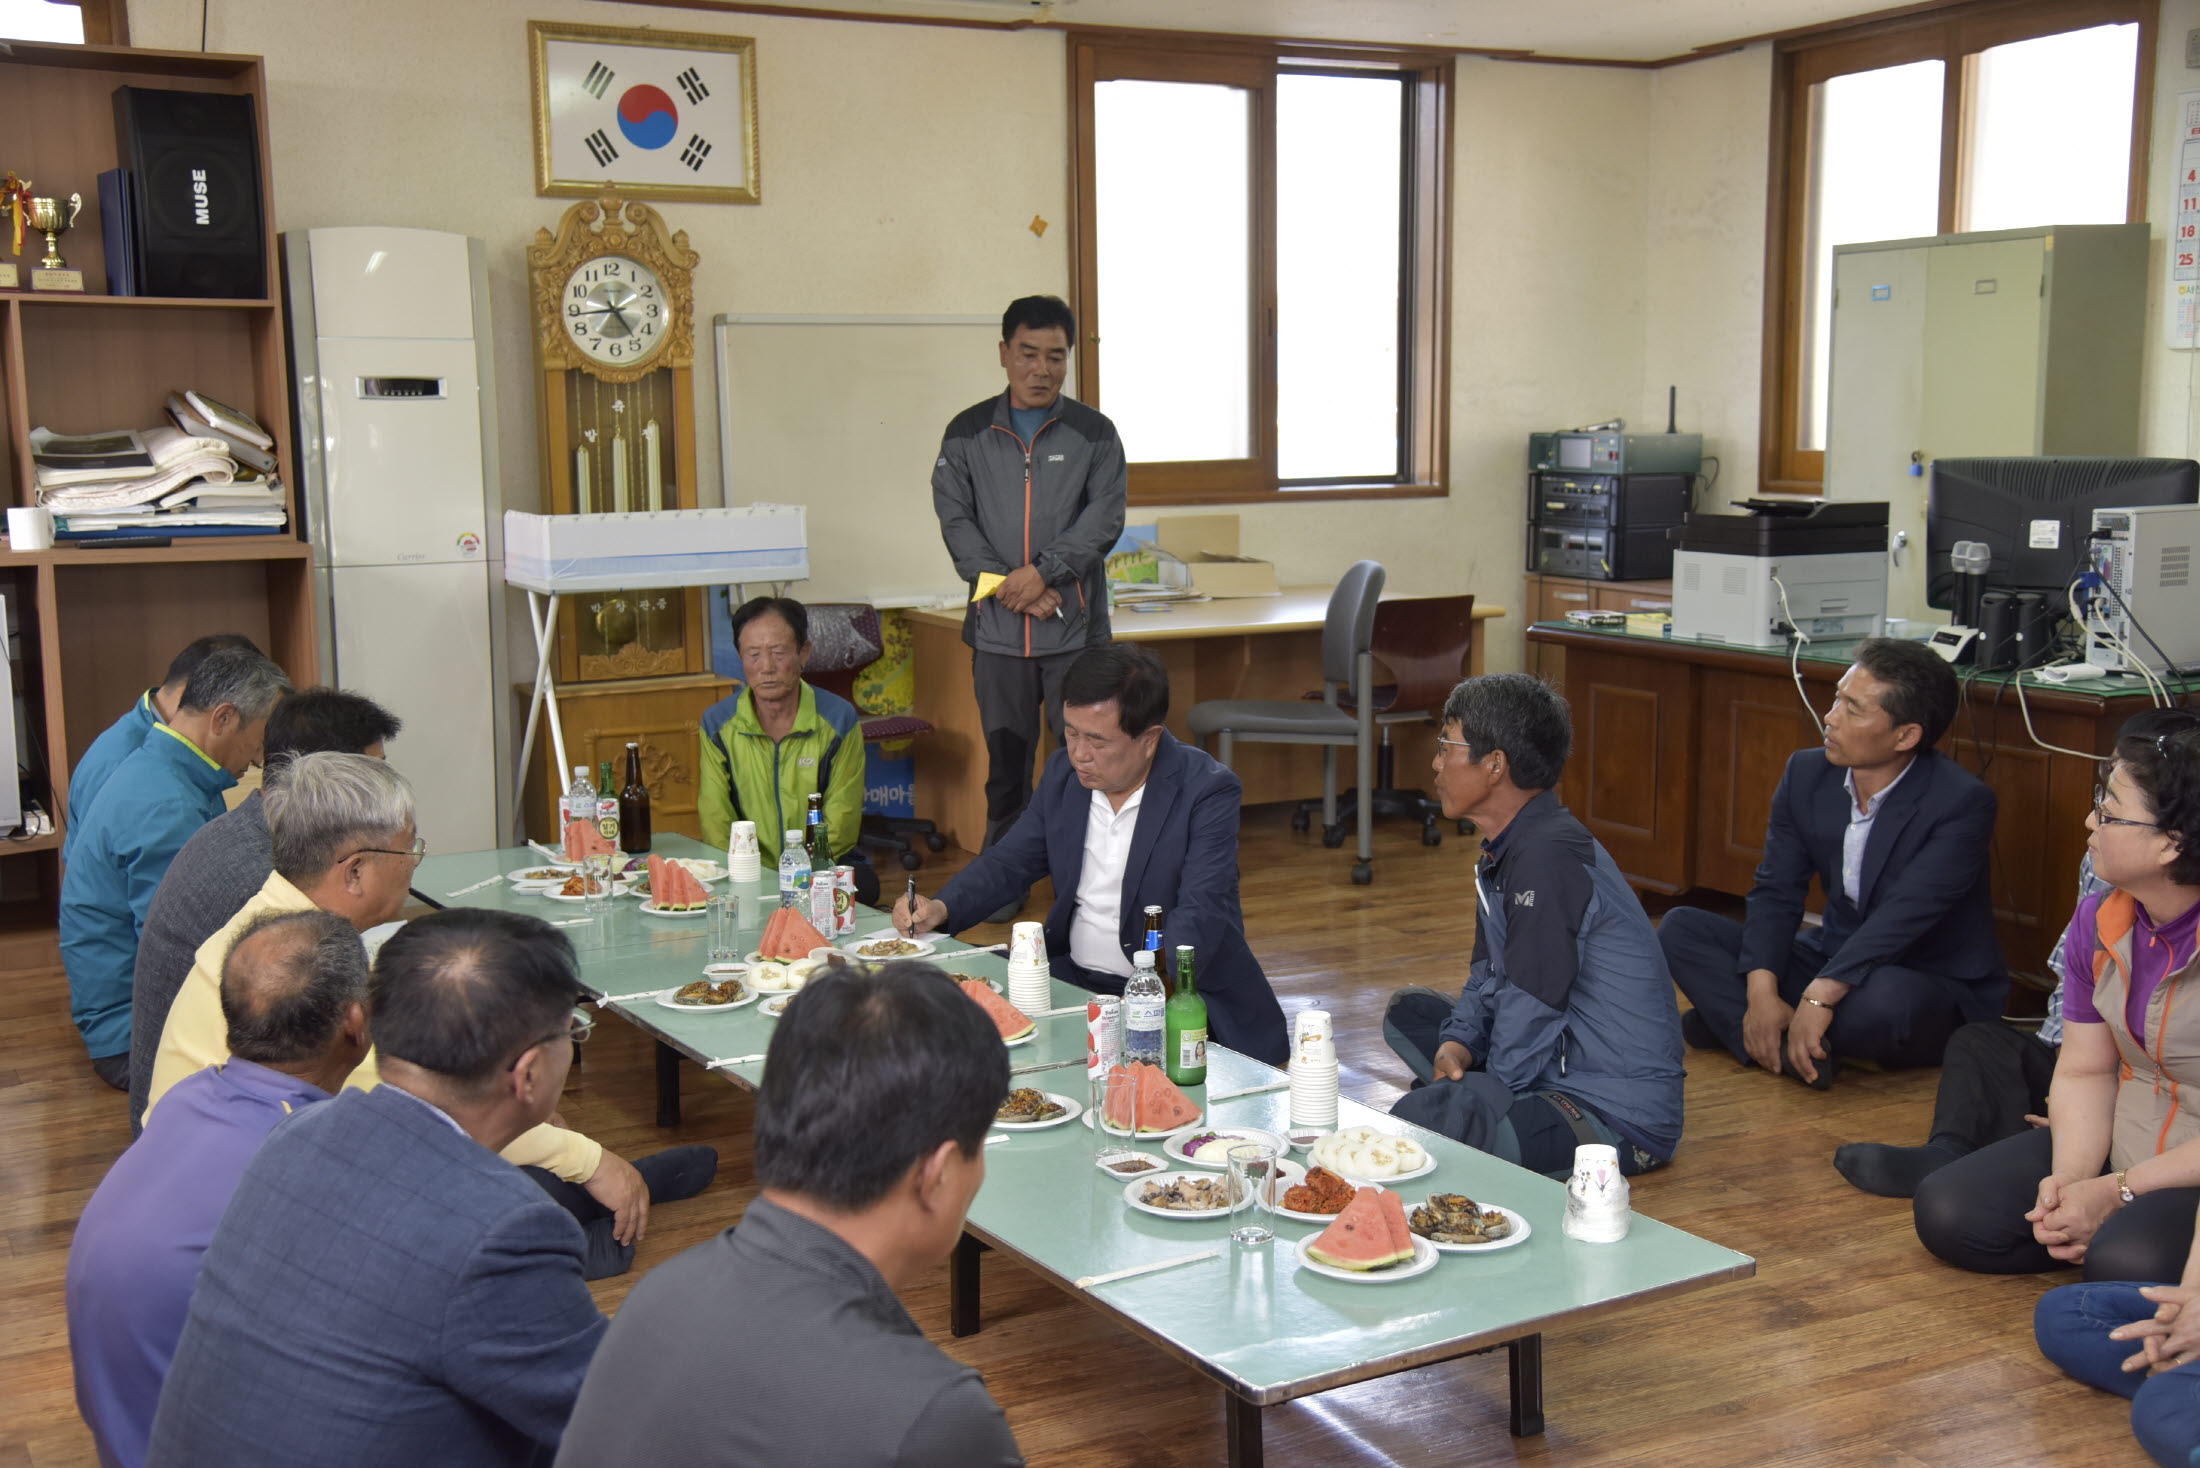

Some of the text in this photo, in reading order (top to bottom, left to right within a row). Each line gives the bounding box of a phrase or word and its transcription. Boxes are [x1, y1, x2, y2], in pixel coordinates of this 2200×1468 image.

[2188, 169, 2196, 182] 4
[192, 169, 210, 225] MUSE
[2184, 198, 2197, 211] 11
[2181, 225, 2195, 238] 18
[2179, 252, 2194, 266] 25
[585, 270, 598, 281] 11
[604, 263, 619, 276] 12
[631, 270, 636, 282] 1
[573, 285, 587, 298] 10
[641, 285, 653, 298] 2
[568, 304, 580, 317] 9
[646, 304, 658, 317] 3
[574, 322, 588, 335] 8
[641, 323, 652, 335] 4
[589, 338, 602, 351] 7
[609, 343, 622, 357] 6
[629, 338, 641, 351] 5
